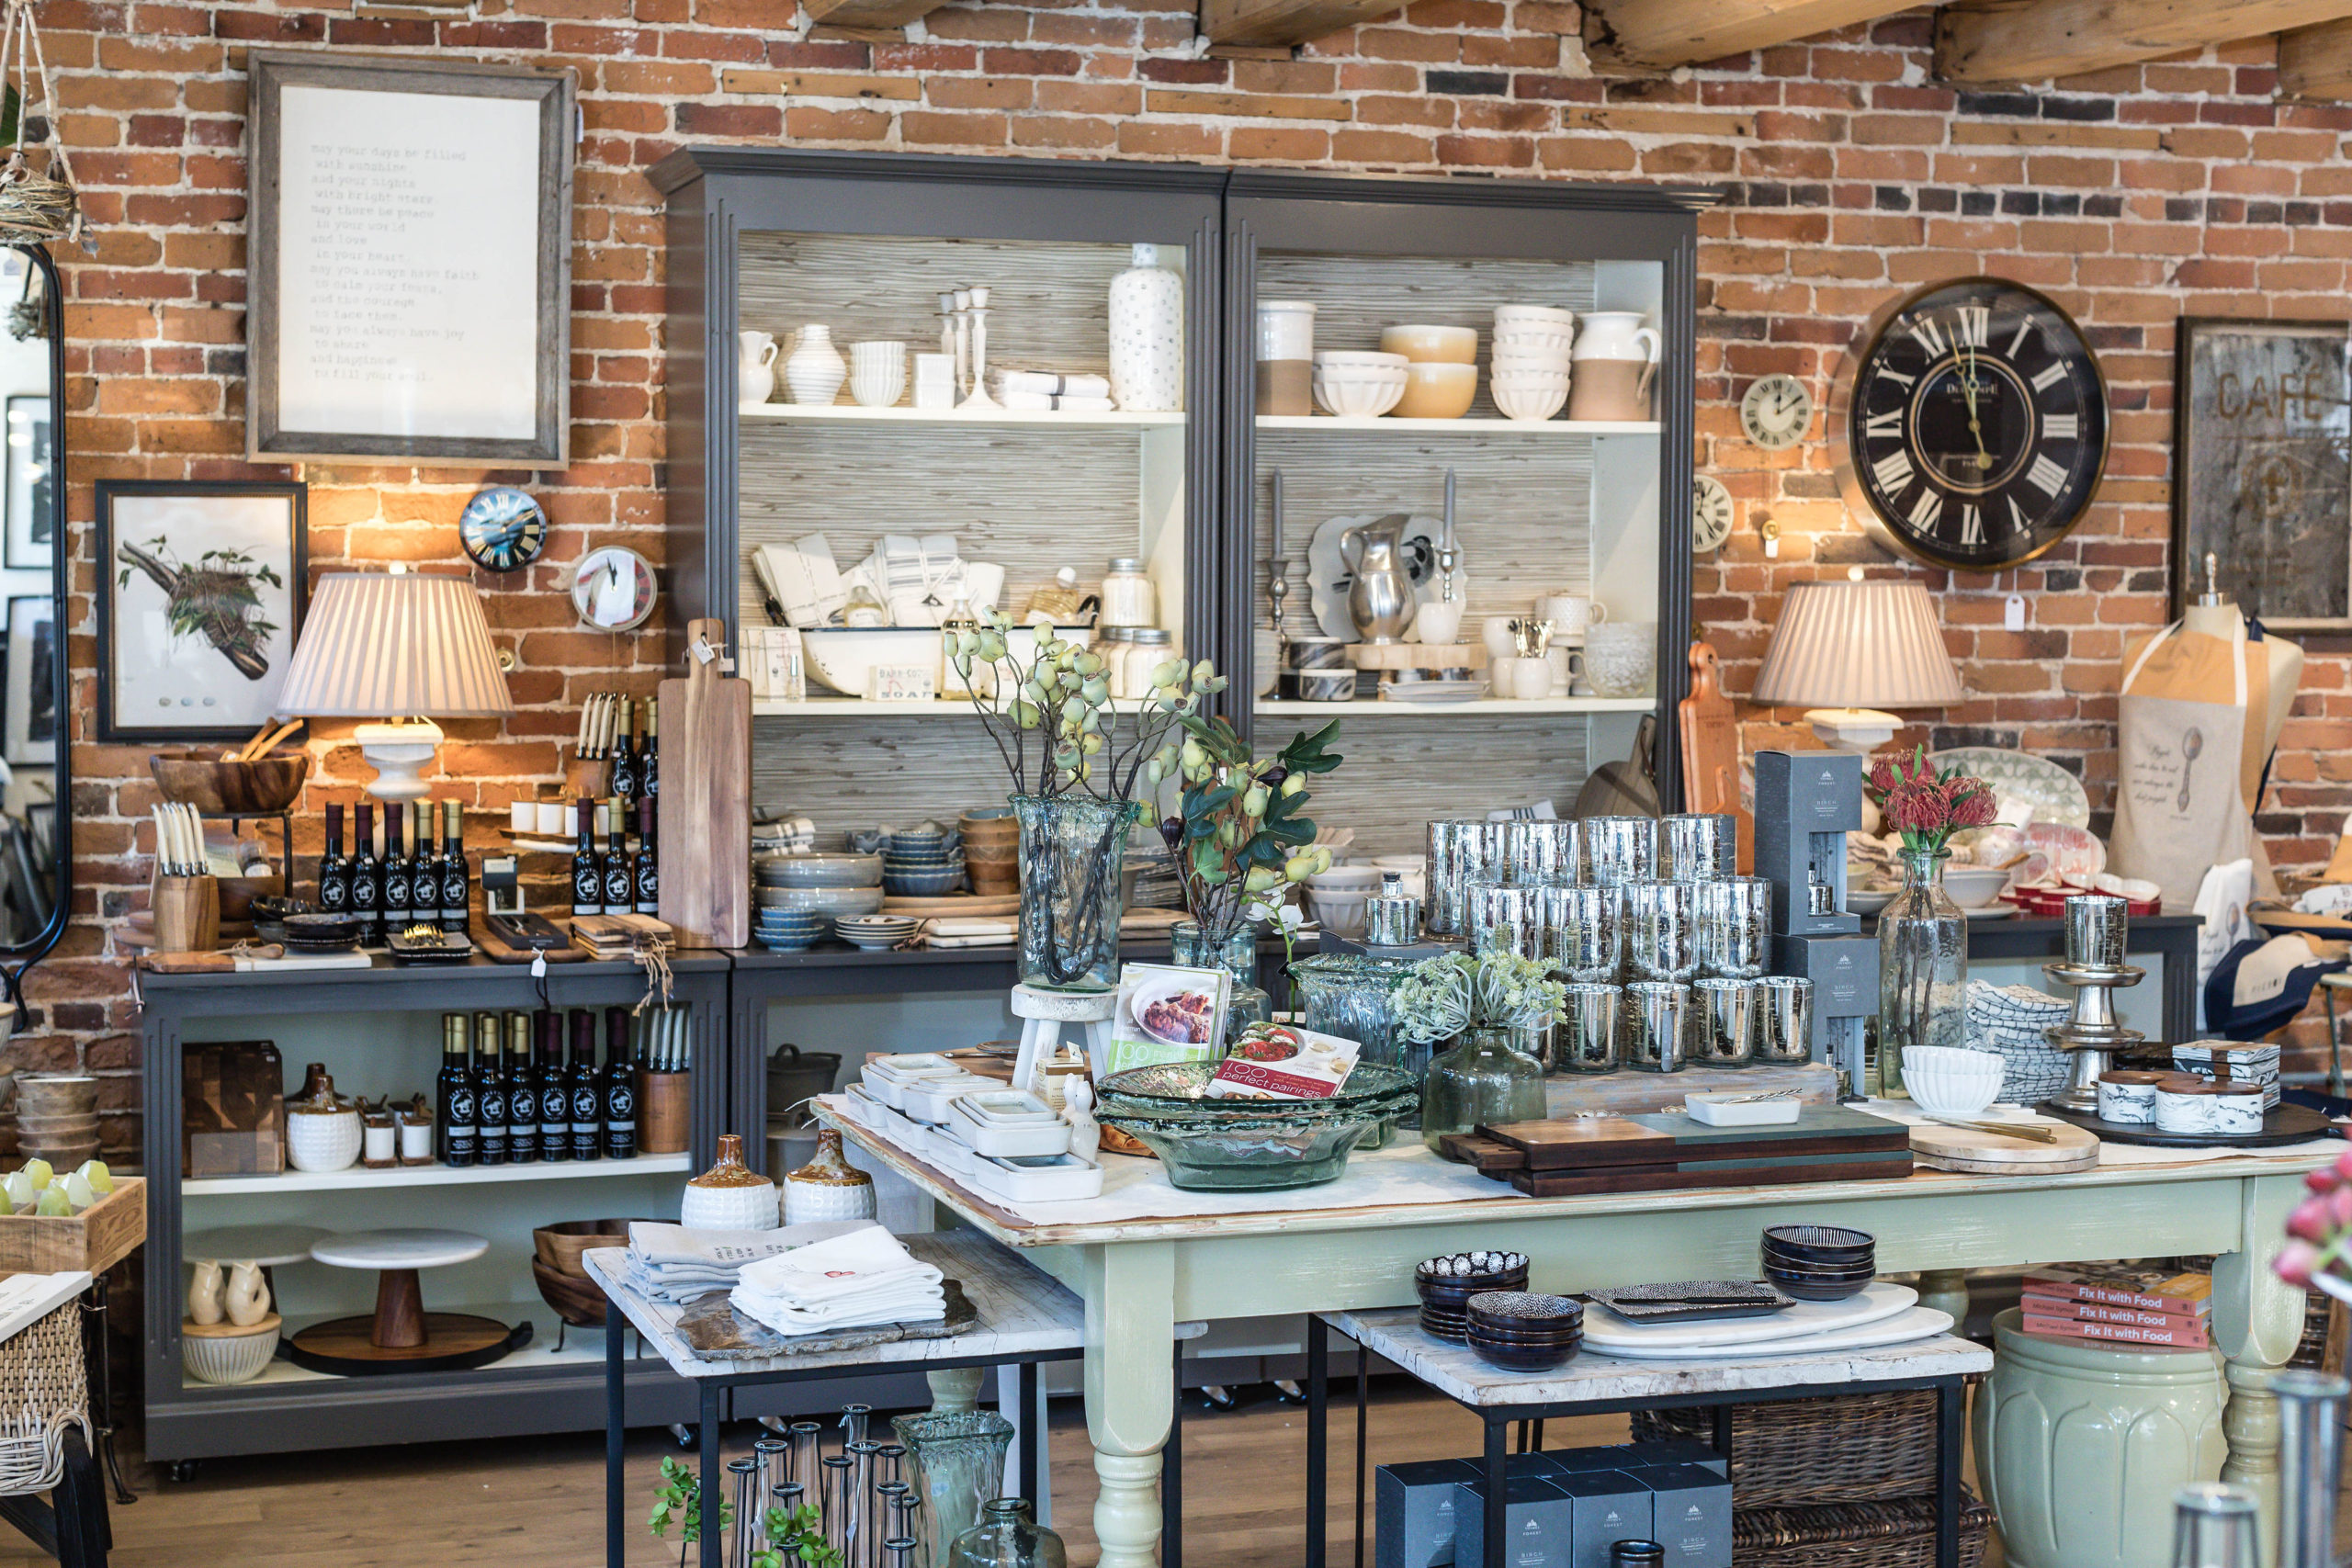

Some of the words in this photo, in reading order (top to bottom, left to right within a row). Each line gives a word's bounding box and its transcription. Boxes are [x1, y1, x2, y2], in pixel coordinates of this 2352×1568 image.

[2218, 367, 2324, 422] CAFÉ
[1227, 1062, 1268, 1078] 100
[1222, 1071, 1269, 1088] perfect
[1269, 1081, 1322, 1099] pairings
[2079, 1288, 2095, 1300] Fix
[2098, 1290, 2105, 1301] It
[2108, 1292, 2132, 1305] with
[2134, 1295, 2162, 1309] Food
[2080, 1307, 2096, 1318] Fix
[2098, 1309, 2107, 1319] It
[2109, 1311, 2134, 1323] with
[2137, 1314, 2166, 1326] Food
[2085, 1325, 2100, 1336] Fix
[2104, 1326, 2112, 1337] It
[2115, 1328, 2140, 1340] with
[2143, 1330, 2172, 1342] Food
